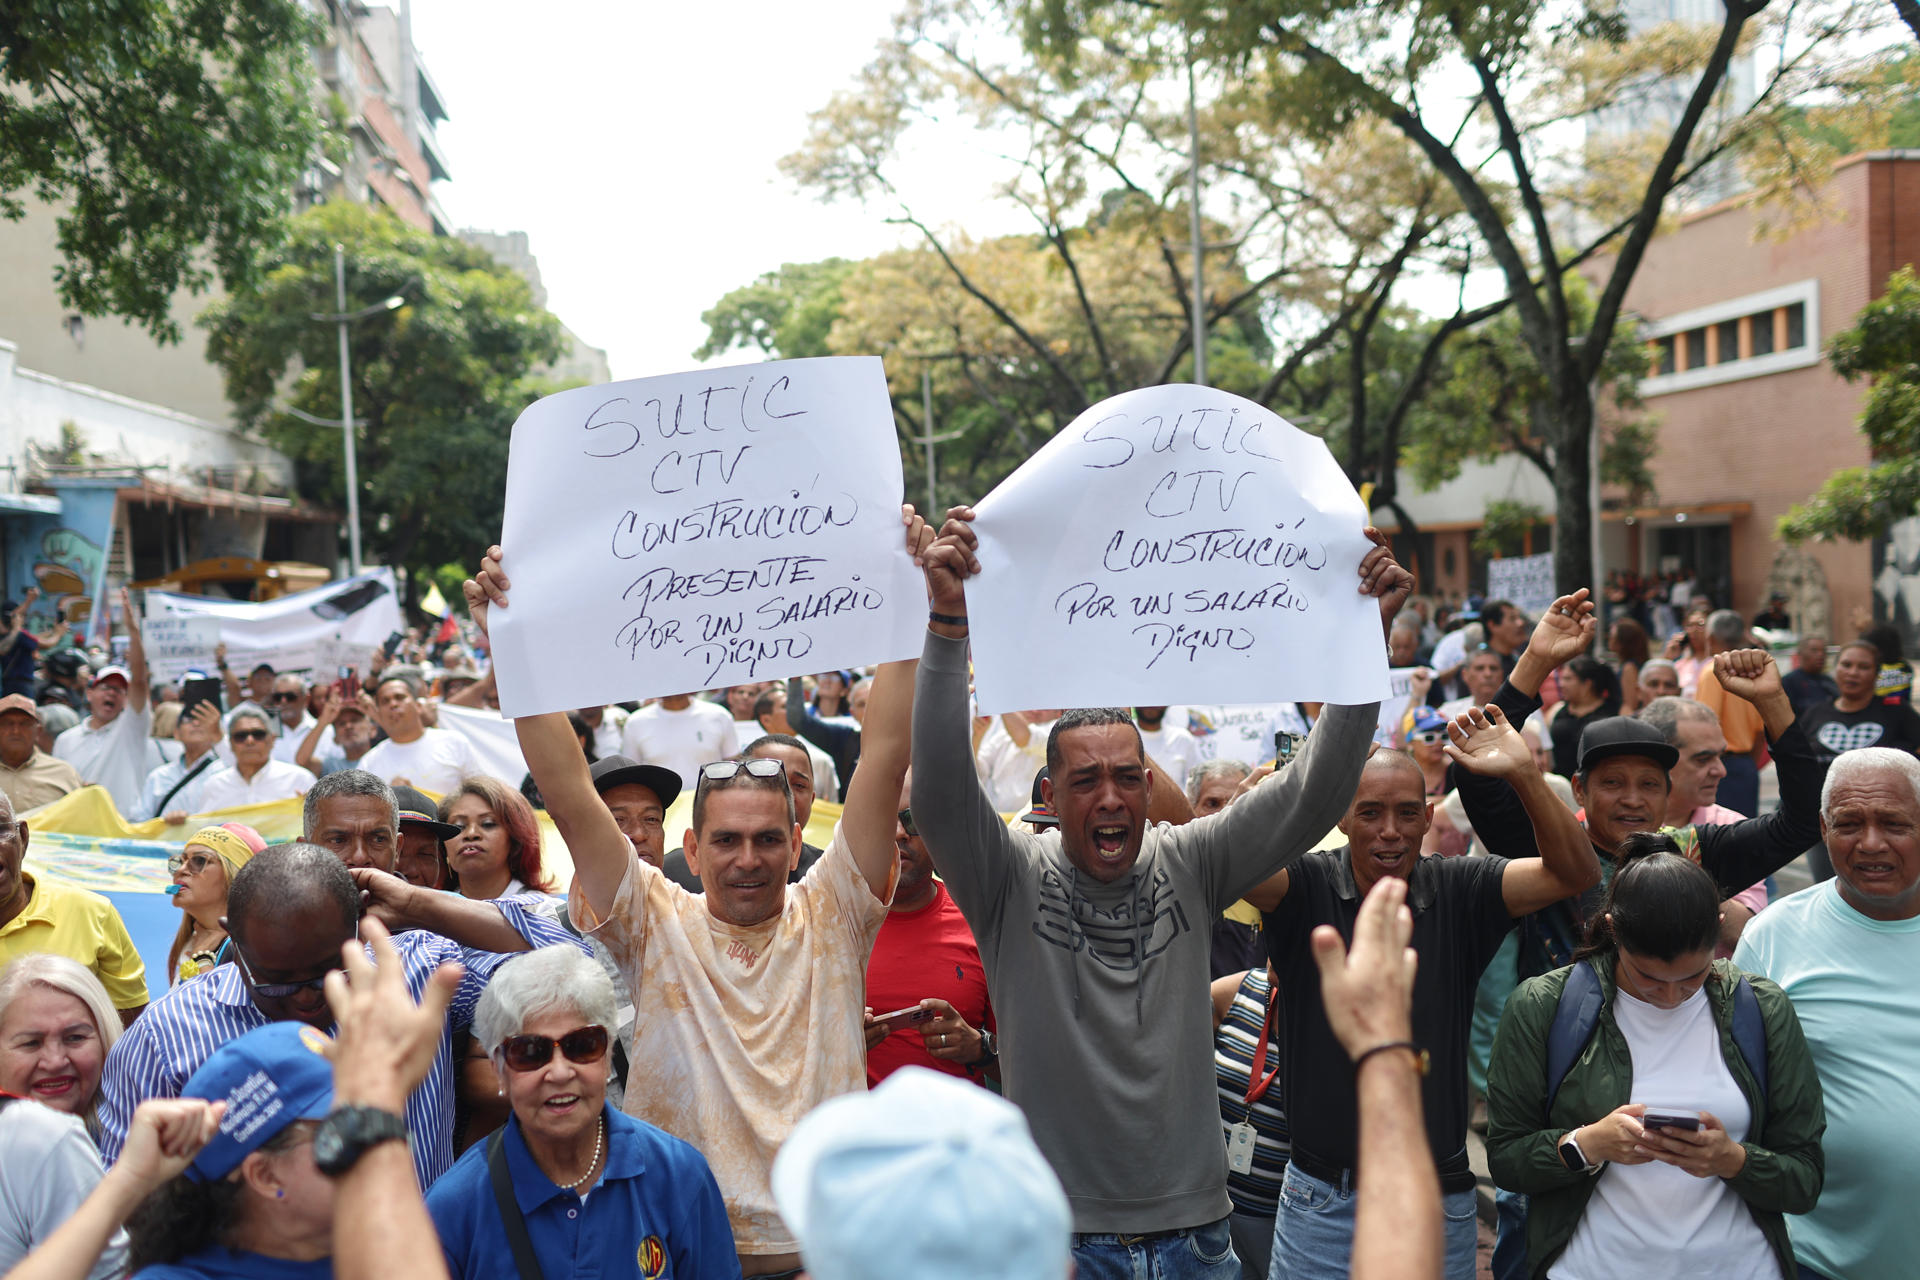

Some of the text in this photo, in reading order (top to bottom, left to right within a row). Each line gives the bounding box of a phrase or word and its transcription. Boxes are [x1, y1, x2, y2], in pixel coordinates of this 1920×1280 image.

[651, 445, 752, 494] CTV
[1145, 470, 1256, 518] CTV
[623, 555, 828, 617] PRESENTE
[1055, 577, 1310, 624] POR UN SALARIO
[615, 574, 884, 660] POR UN SALARIO
